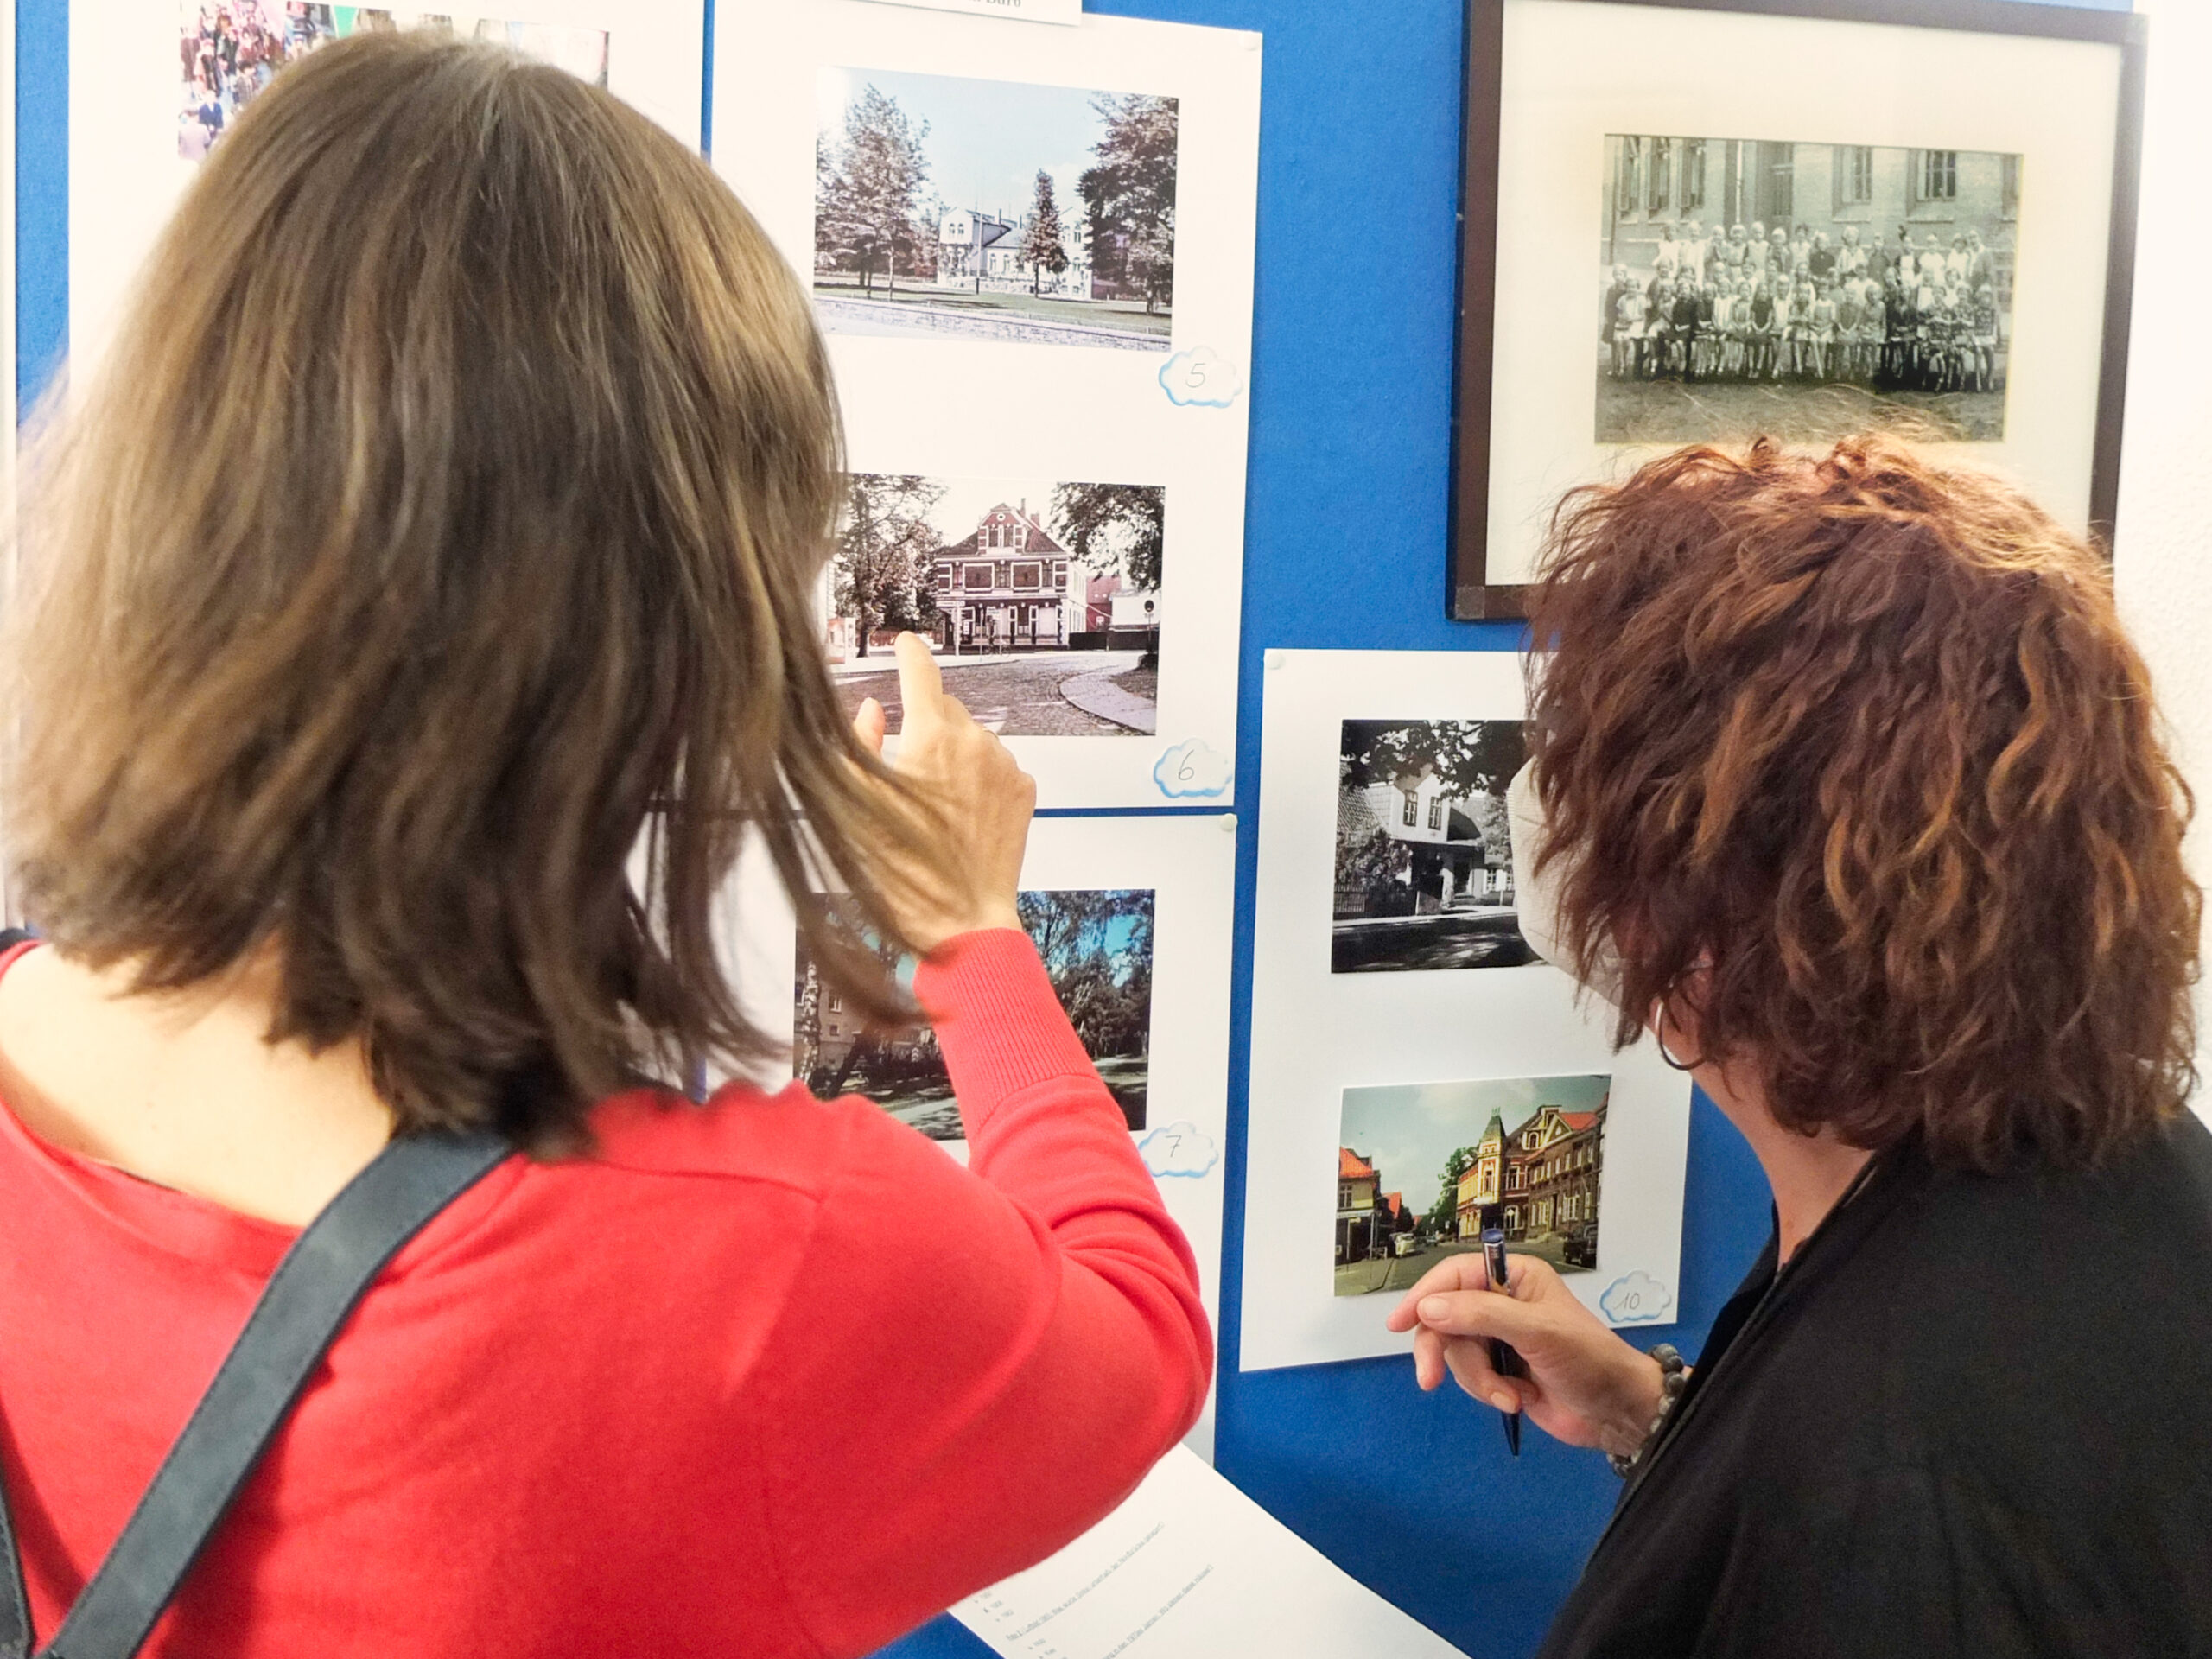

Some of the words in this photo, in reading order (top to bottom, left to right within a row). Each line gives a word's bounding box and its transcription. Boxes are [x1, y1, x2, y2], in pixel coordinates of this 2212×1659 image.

[1185, 362, 1206, 388] 5
[1178, 749, 1195, 781] 6
[1164, 1134, 1182, 1158] 7
[1613, 1292, 1641, 1311] 10
